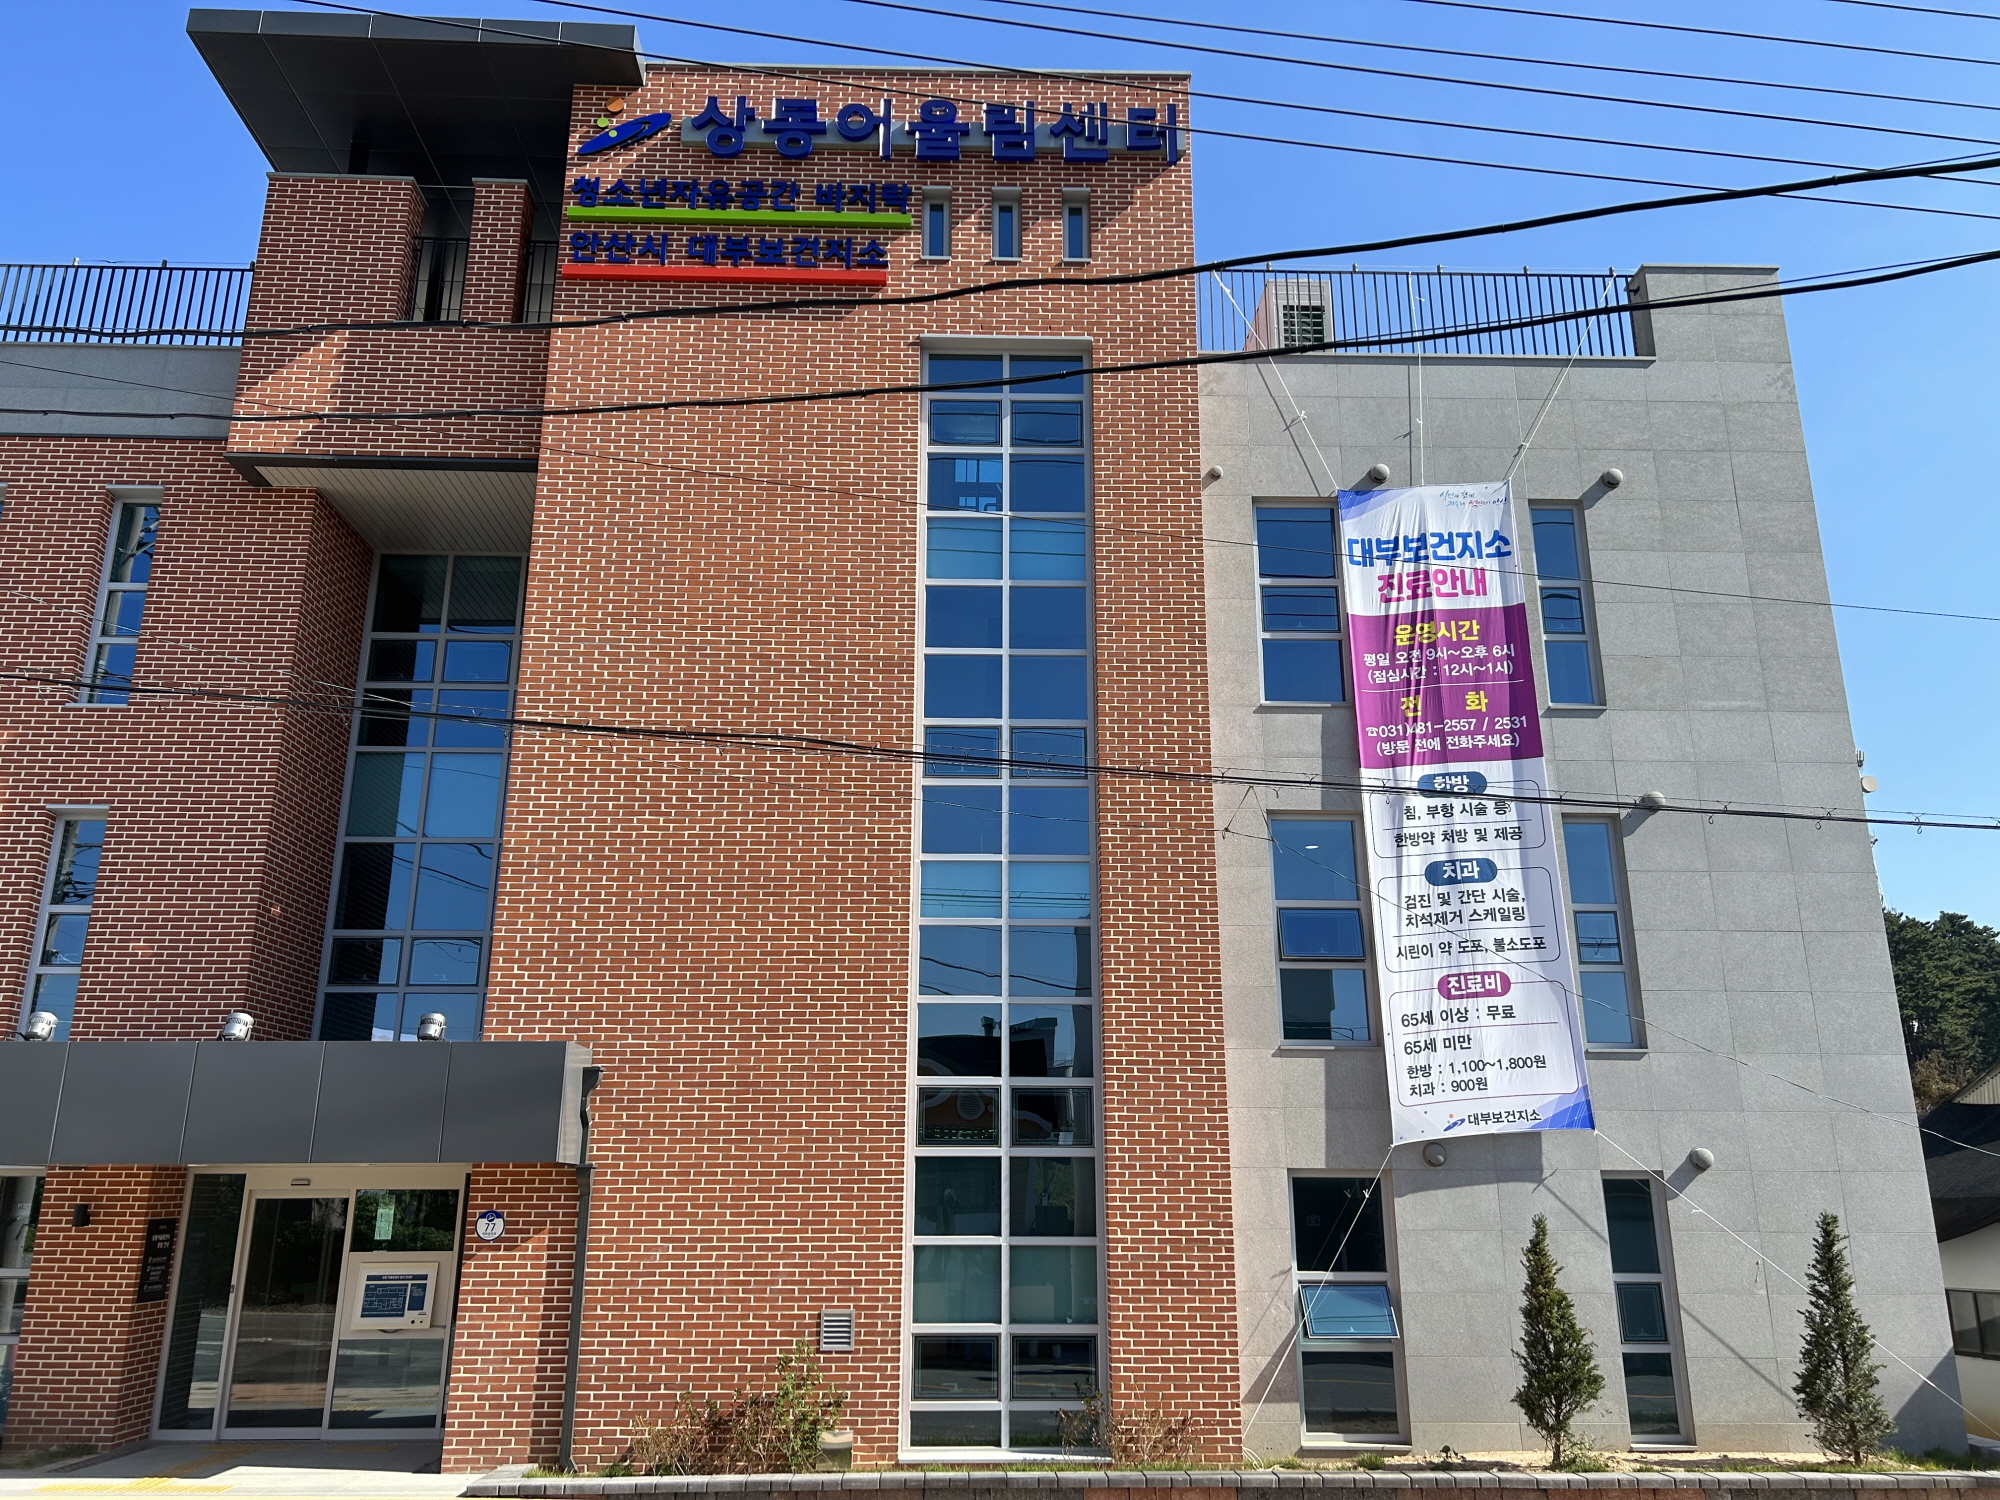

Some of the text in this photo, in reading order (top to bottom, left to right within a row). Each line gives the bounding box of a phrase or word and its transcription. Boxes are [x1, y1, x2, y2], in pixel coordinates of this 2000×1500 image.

[690, 95, 1178, 166] 상동어울림센터
[571, 175, 912, 214] 청소년자유공간 바지락
[570, 231, 889, 269] 안산시 대부보건지소
[1347, 530, 1512, 568] 대부보건지소
[1377, 567, 1488, 604] 진료안내
[1393, 619, 1480, 646] 운영시간
[1363, 652, 1390, 667] 평일
[1395, 648, 1422, 664] 오전
[1492, 643, 1515, 657] 6시
[1367, 665, 1426, 684] (점심시간
[1443, 661, 1513, 676] 12시~1시)
[1494, 715, 1528, 730] 2531
[1376, 732, 1520, 757] (방문 전에 전화주세요)
[1433, 775, 1470, 794] 한방
[1403, 801, 1508, 821] 침, 부항 시술 등
[1394, 826, 1523, 848] 한방약 처방 및 제공
[1442, 860, 1480, 880] 치과
[1404, 888, 1526, 910] 검진 및 간단 시술,
[1405, 906, 1526, 928] 치석제거 스케일링
[1396, 936, 1547, 960] 시린이 약 도포, 불소도포
[1447, 972, 1503, 997] 진료비
[1401, 1009, 1434, 1028] 65세
[1439, 1006, 1469, 1024] 이상
[1486, 1004, 1516, 1020] 무료
[1403, 1034, 1473, 1056] 65세 미만
[1406, 1063, 1432, 1080] 한방
[1448, 1054, 1547, 1075] 1,100~1,800원
[1409, 1081, 1436, 1098] 치과
[1451, 1076, 1489, 1093] 900원
[1467, 1108, 1542, 1126] 대부보건지소
[484, 1222, 497, 1232] 77
